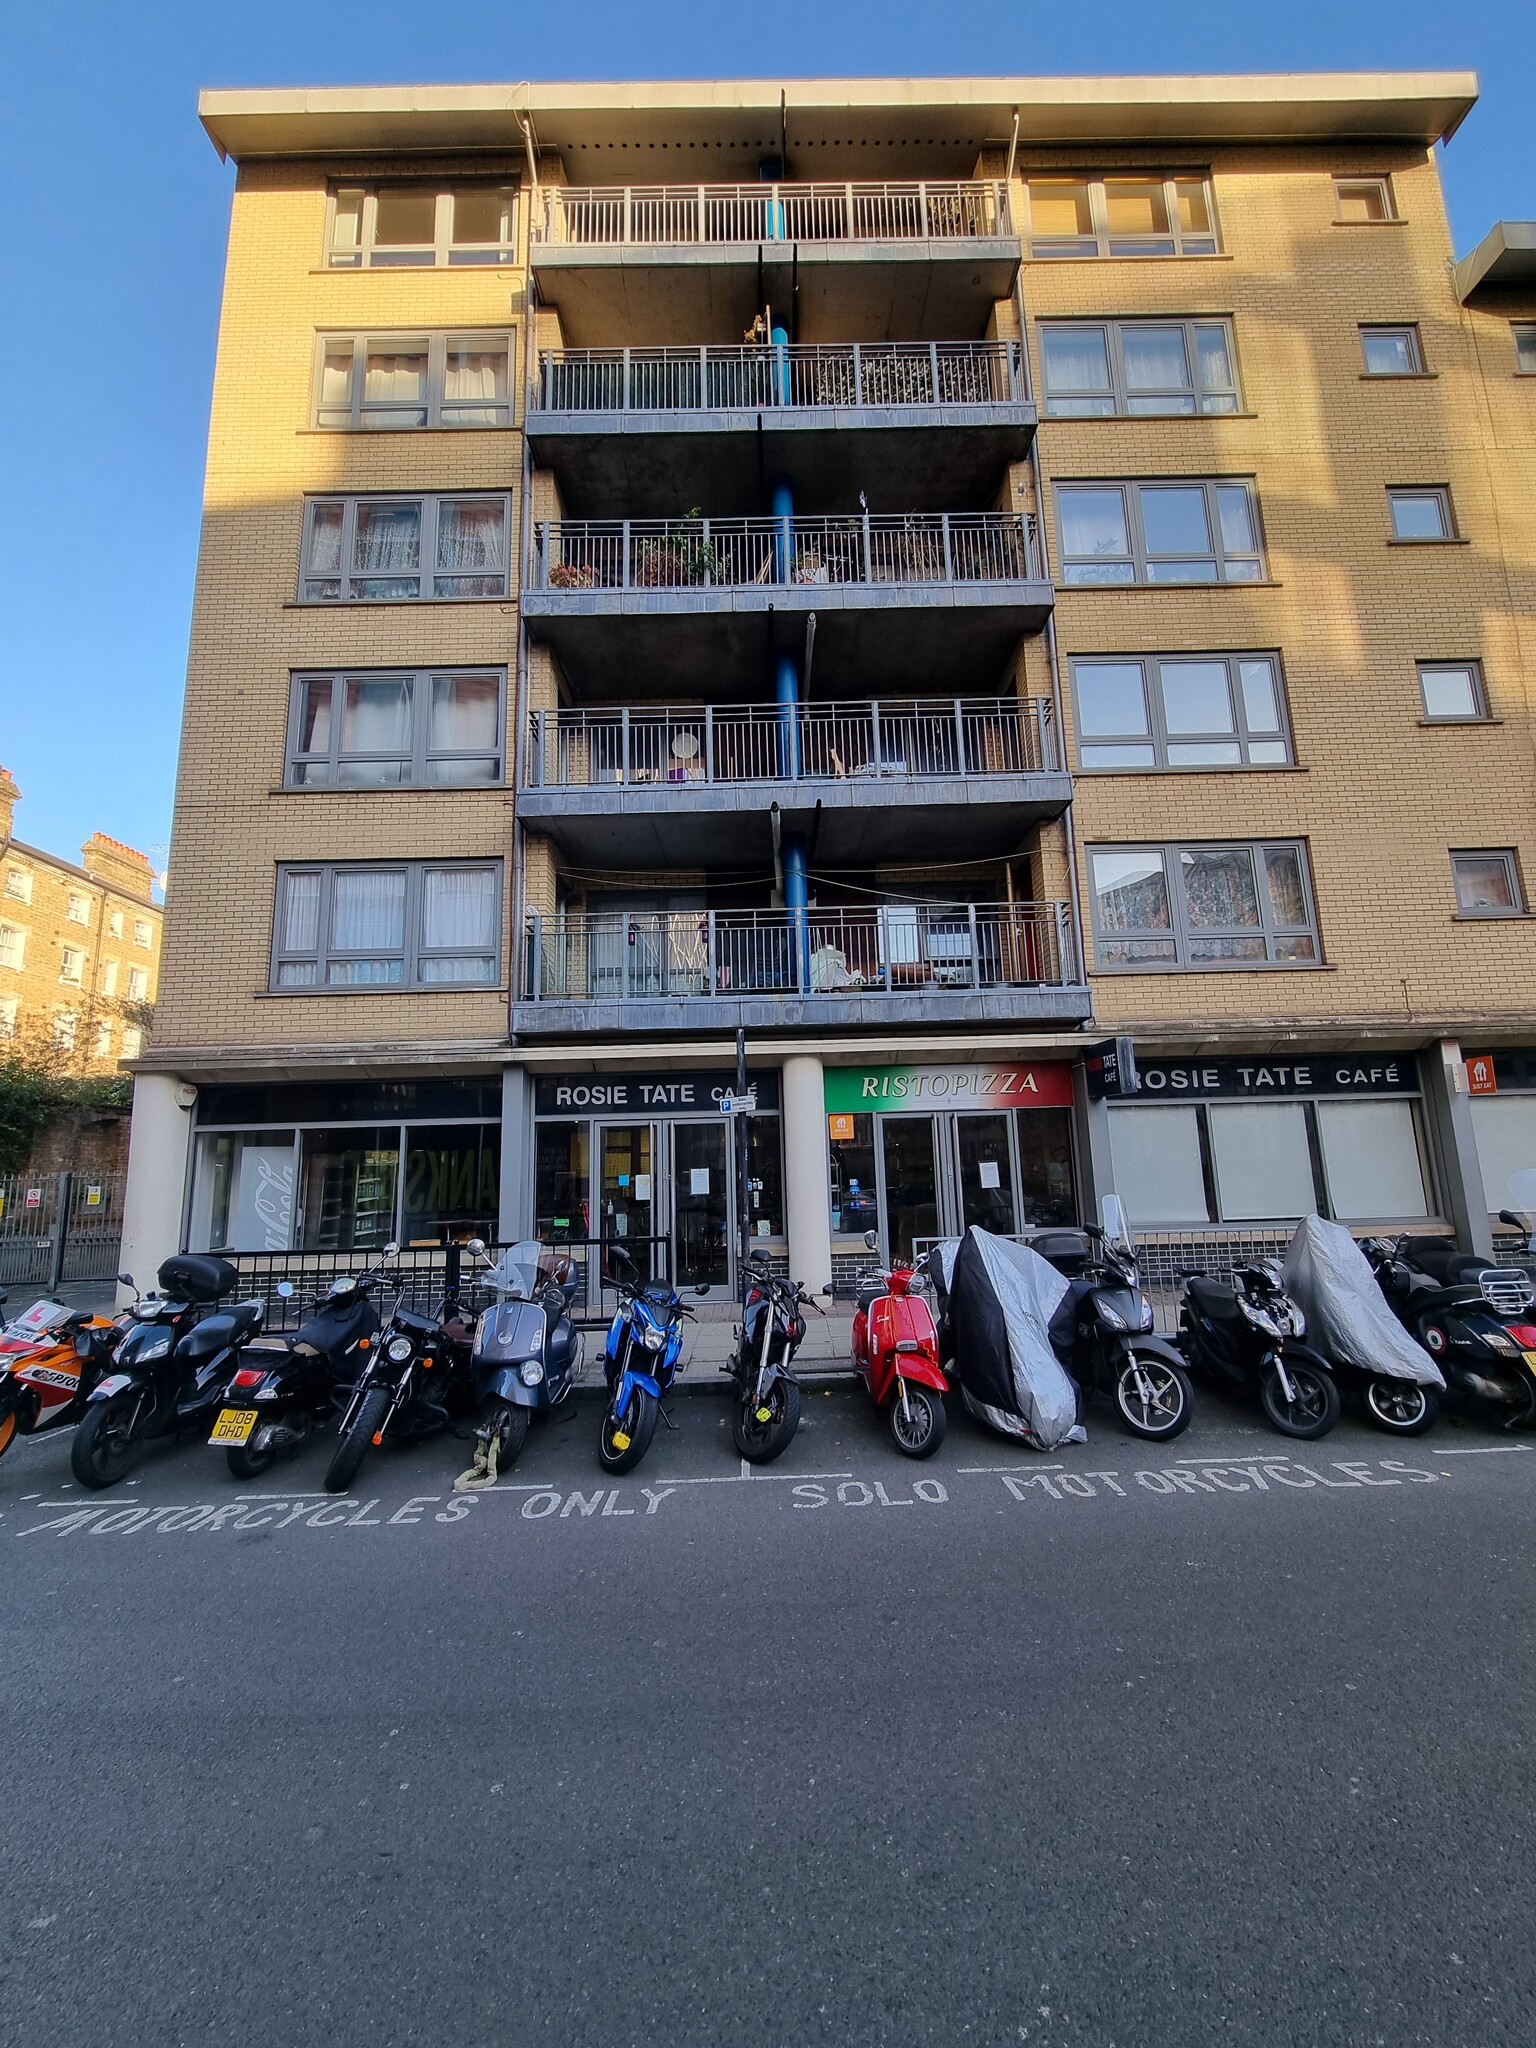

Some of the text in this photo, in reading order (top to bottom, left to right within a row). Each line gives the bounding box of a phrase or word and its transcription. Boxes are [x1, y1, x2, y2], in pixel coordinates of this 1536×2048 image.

[1103, 1053, 1117, 1068] TATE
[861, 1071, 1040, 1098] RISTOPIZZA
[1104, 1069, 1117, 1083] CAFÉ
[1236, 1066, 1313, 1087] TATE
[1335, 1063, 1400, 1084] CAFÉ
[556, 1081, 759, 1106] ROSIE TATE CAÉ
[220, 1411, 254, 1425] LJ08
[217, 1424, 244, 1438] DHD
[791, 1479, 950, 1508] SOLO
[16, 1487, 676, 1536] MOTORCYCLES ONLY
